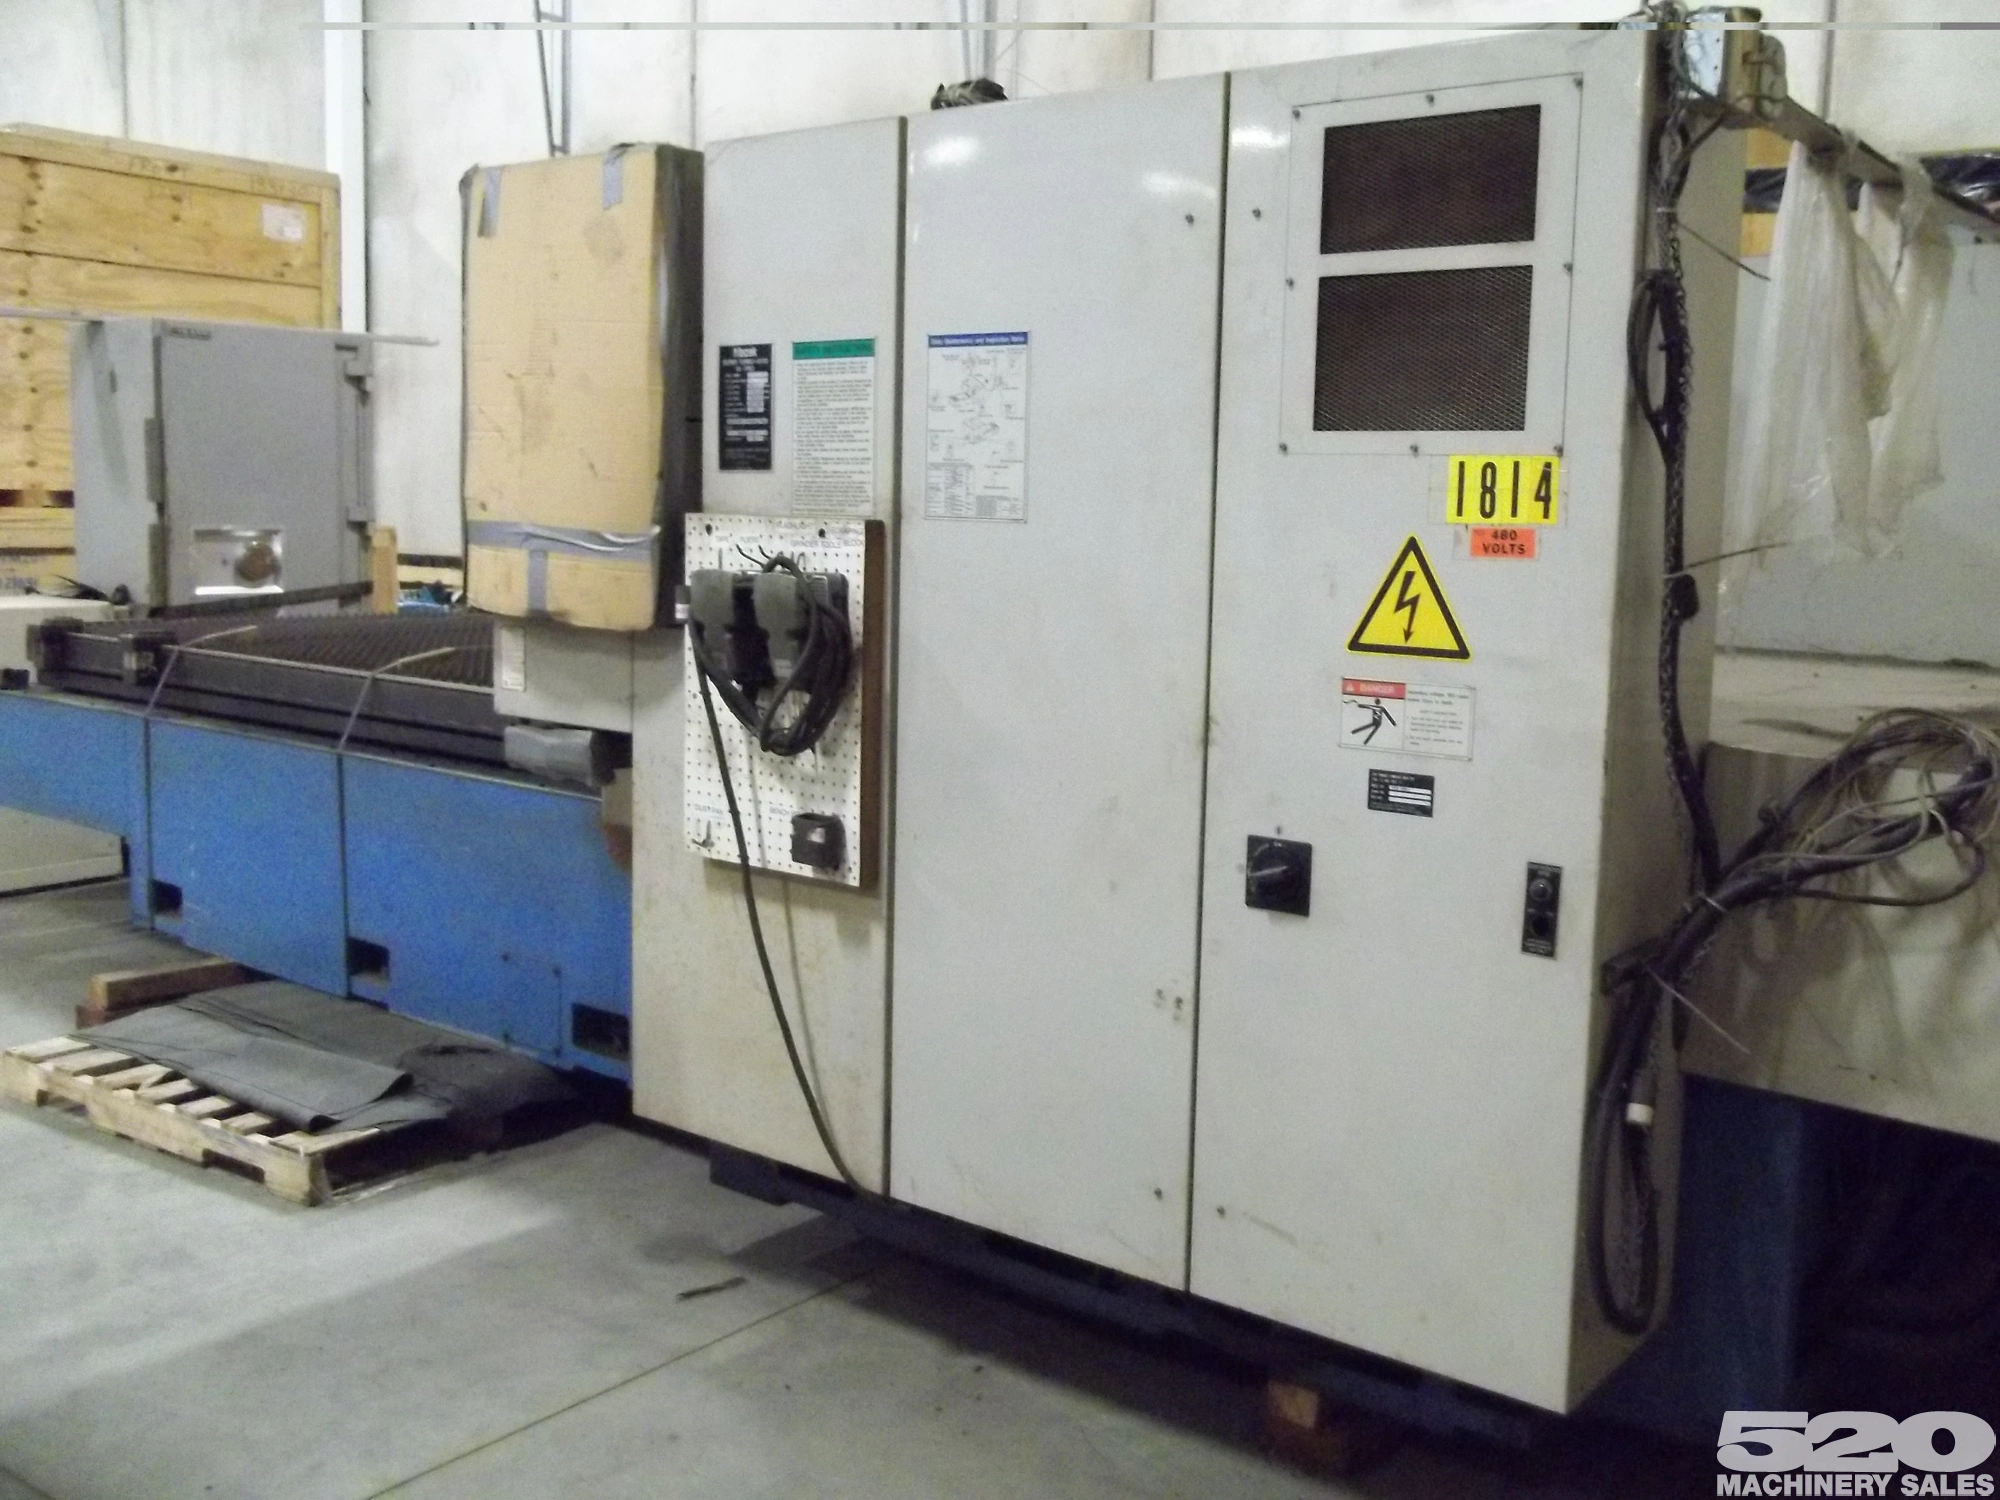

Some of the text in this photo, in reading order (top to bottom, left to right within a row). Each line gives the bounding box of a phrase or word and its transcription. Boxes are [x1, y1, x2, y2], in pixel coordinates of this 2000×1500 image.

[1457, 461, 1552, 519] 1814
[1492, 529, 1517, 541] 480
[1482, 543, 1526, 555] VOLTS
[1360, 682, 1395, 694] DANGER
